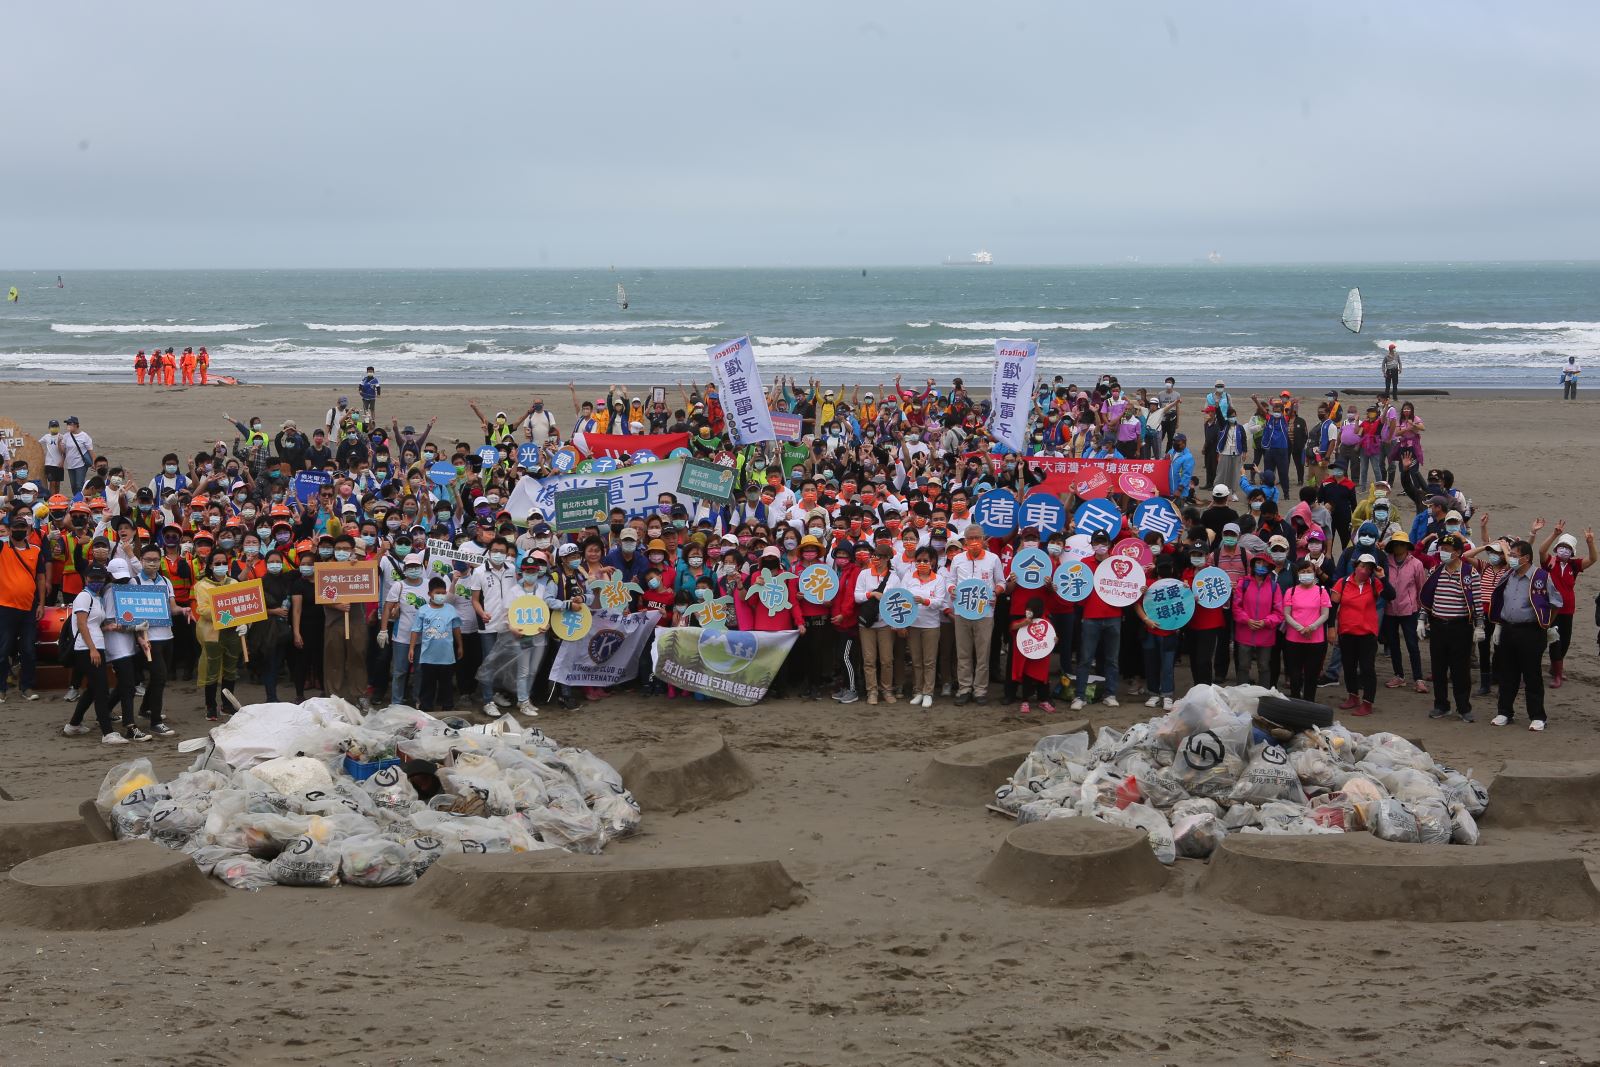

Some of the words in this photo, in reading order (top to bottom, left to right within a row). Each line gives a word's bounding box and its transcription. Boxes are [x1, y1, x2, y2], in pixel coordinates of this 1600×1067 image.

[479, 449, 494, 464] 億
[520, 447, 537, 463] 光
[555, 452, 571, 470] 電
[596, 460, 613, 473] 子
[981, 497, 1014, 529] 遠
[1026, 502, 1060, 534] 東
[1077, 503, 1119, 538] 百
[1139, 504, 1179, 543] 貨
[1019, 555, 1046, 584] 合
[1059, 565, 1088, 597] 淨
[602, 581, 632, 607] 新
[763, 579, 785, 606] 市
[803, 567, 833, 601] 秋
[1152, 585, 1183, 603] 友愛
[1196, 577, 1228, 602] 灘
[886, 592, 913, 624] 季
[958, 585, 989, 614] 聯
[1155, 602, 1186, 620] 環境
[516, 607, 545, 624] 111
[561, 611, 585, 636] 年
[700, 602, 727, 626] 北
